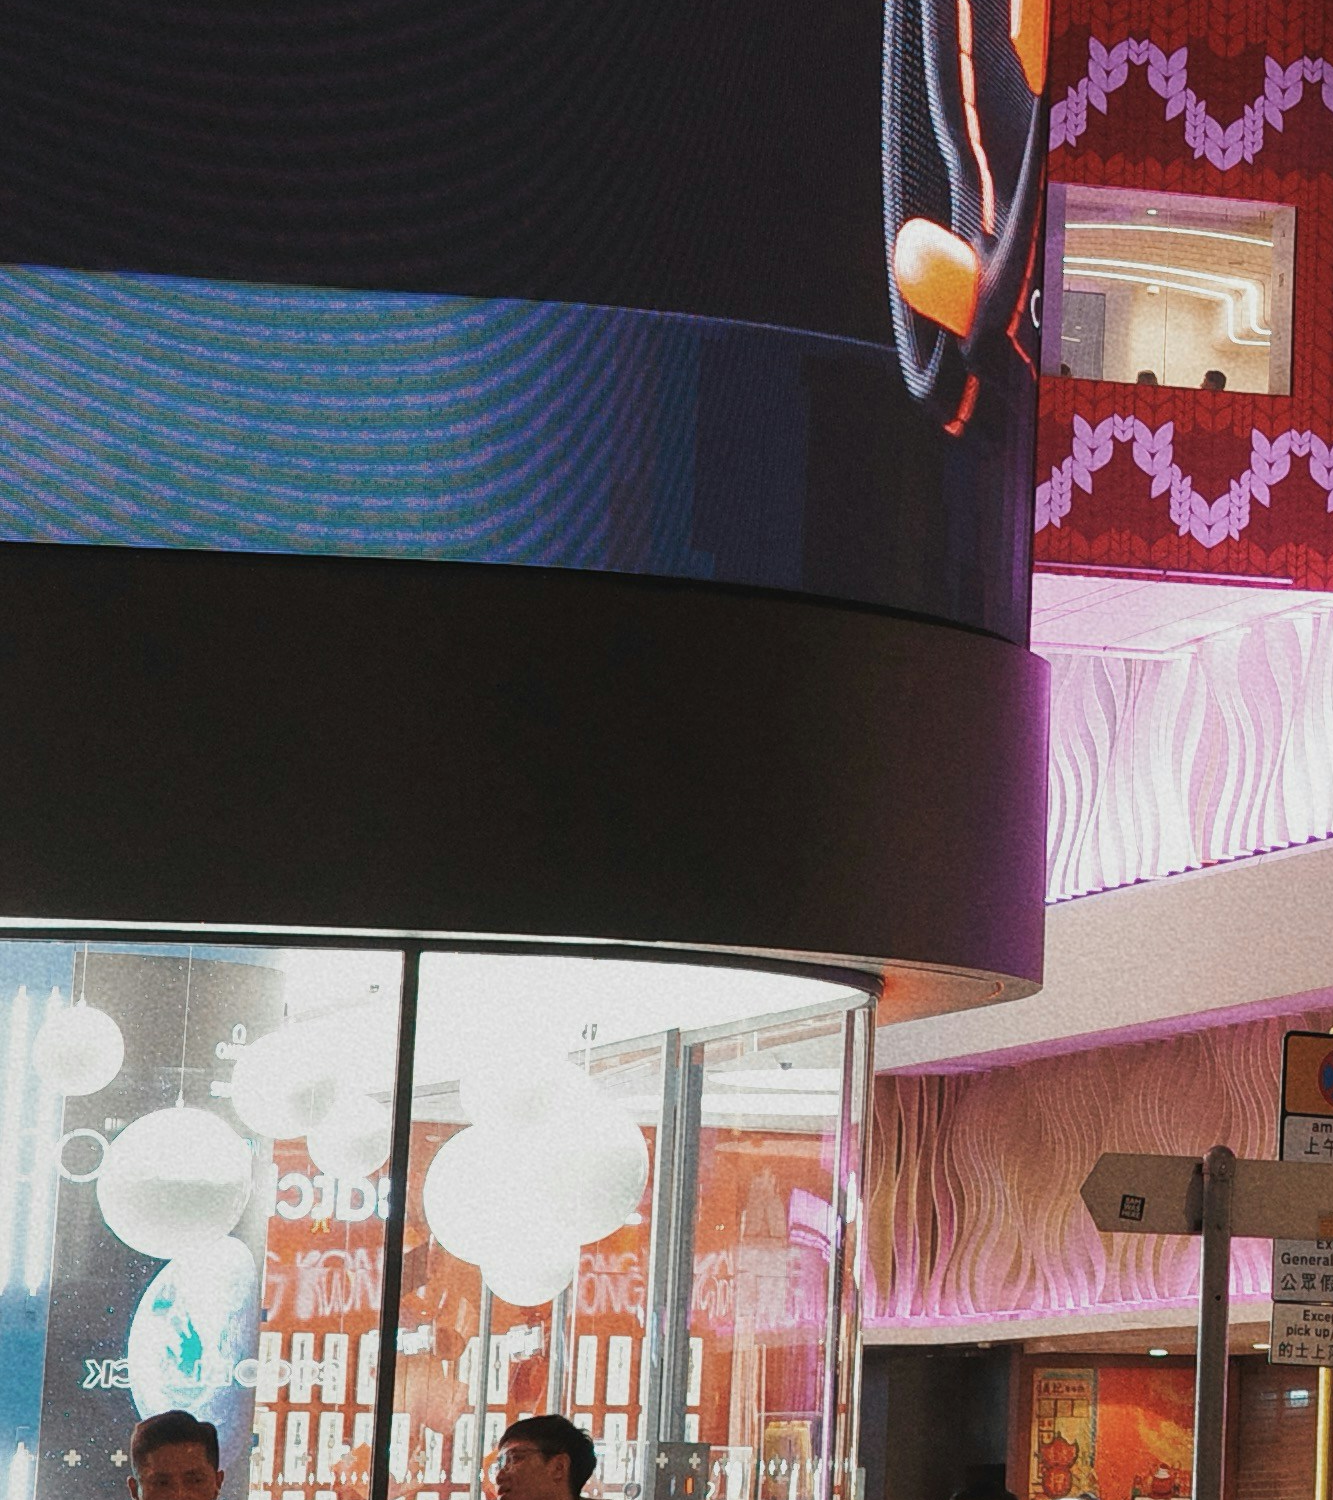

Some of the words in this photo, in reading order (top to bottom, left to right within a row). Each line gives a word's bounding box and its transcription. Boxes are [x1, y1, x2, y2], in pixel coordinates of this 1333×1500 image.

[1311, 1121, 1333, 1133] am
[1281, 1252, 1333, 1268] General
[1286, 1324, 1312, 1340] pick
